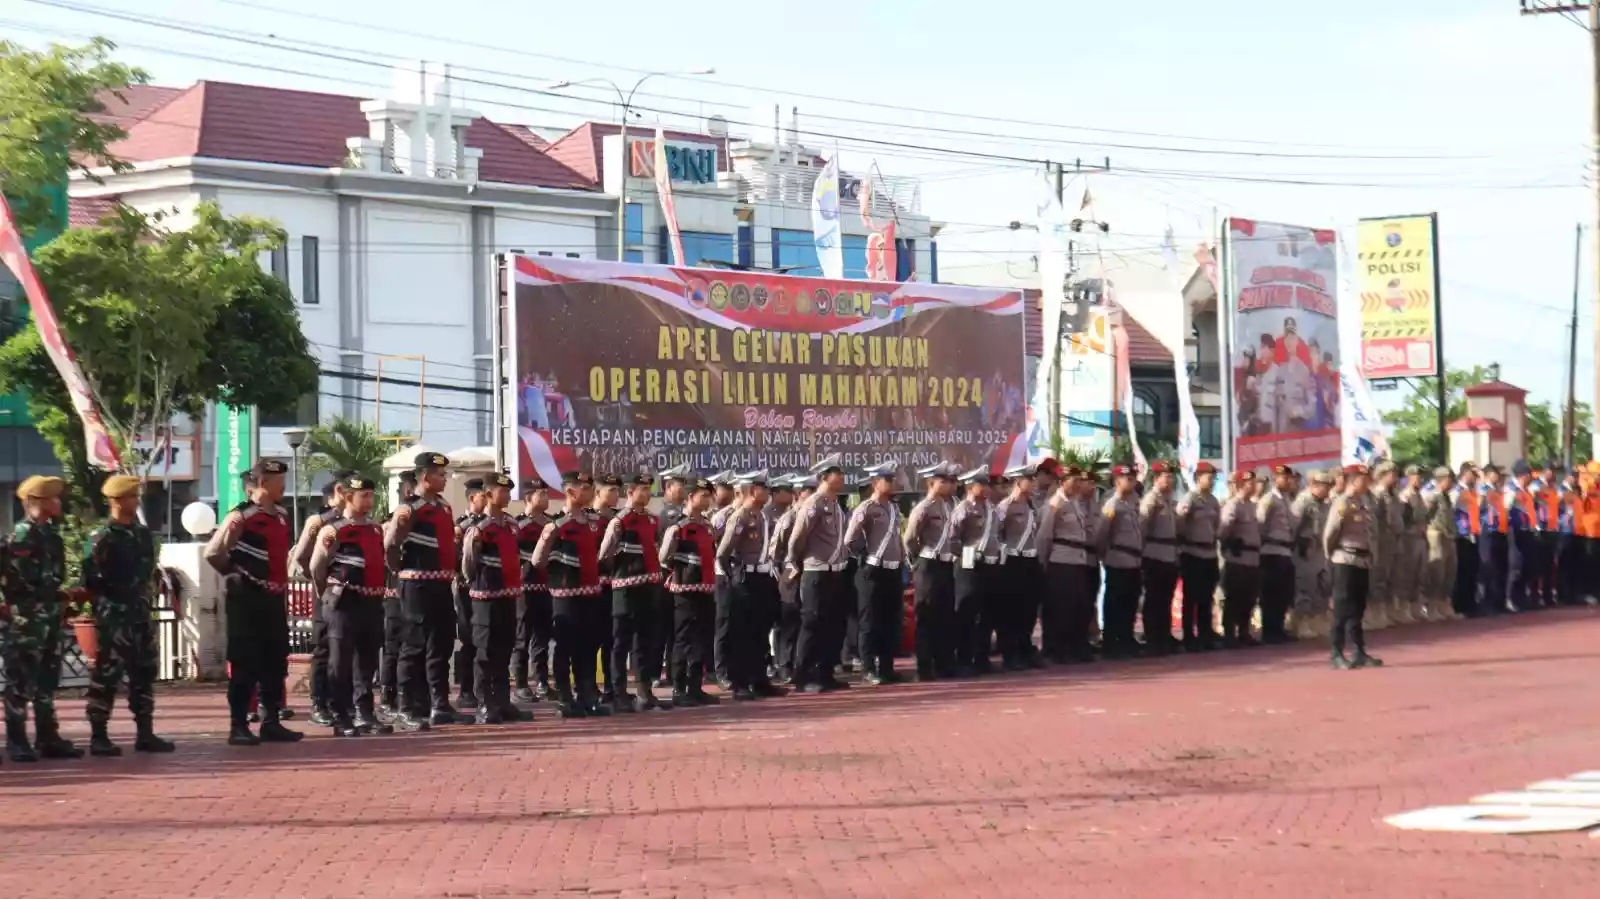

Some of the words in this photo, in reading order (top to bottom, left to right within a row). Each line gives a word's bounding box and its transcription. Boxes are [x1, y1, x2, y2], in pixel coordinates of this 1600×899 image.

[665, 145, 716, 184] BNI
[1368, 262, 1420, 275] POLISI
[657, 325, 721, 362] APEL
[732, 328, 811, 365] GELAR
[821, 333, 929, 369] PASUKAN
[589, 365, 711, 404] OPERASI
[722, 371, 788, 406] LILIN
[800, 373, 918, 408] MAHAKAM
[927, 376, 983, 408] 2024
[744, 406, 796, 428] Dalam
[802, 408, 858, 431] Rangka
[551, 428, 635, 445] KESIAPAN
[643, 429, 756, 445] PENGAMANAN
[762, 431, 810, 445] NATAL
[816, 432, 848, 445] 2024
[854, 431, 883, 445] DAN
[889, 431, 934, 444] TAHUN
[939, 431, 973, 444] BARU
[977, 430, 1009, 444] 2025
[657, 453, 672, 469] DI
[680, 452, 750, 469] WILAYAH
[758, 452, 810, 468] HUKUM
[874, 451, 939, 467] BONTANG
